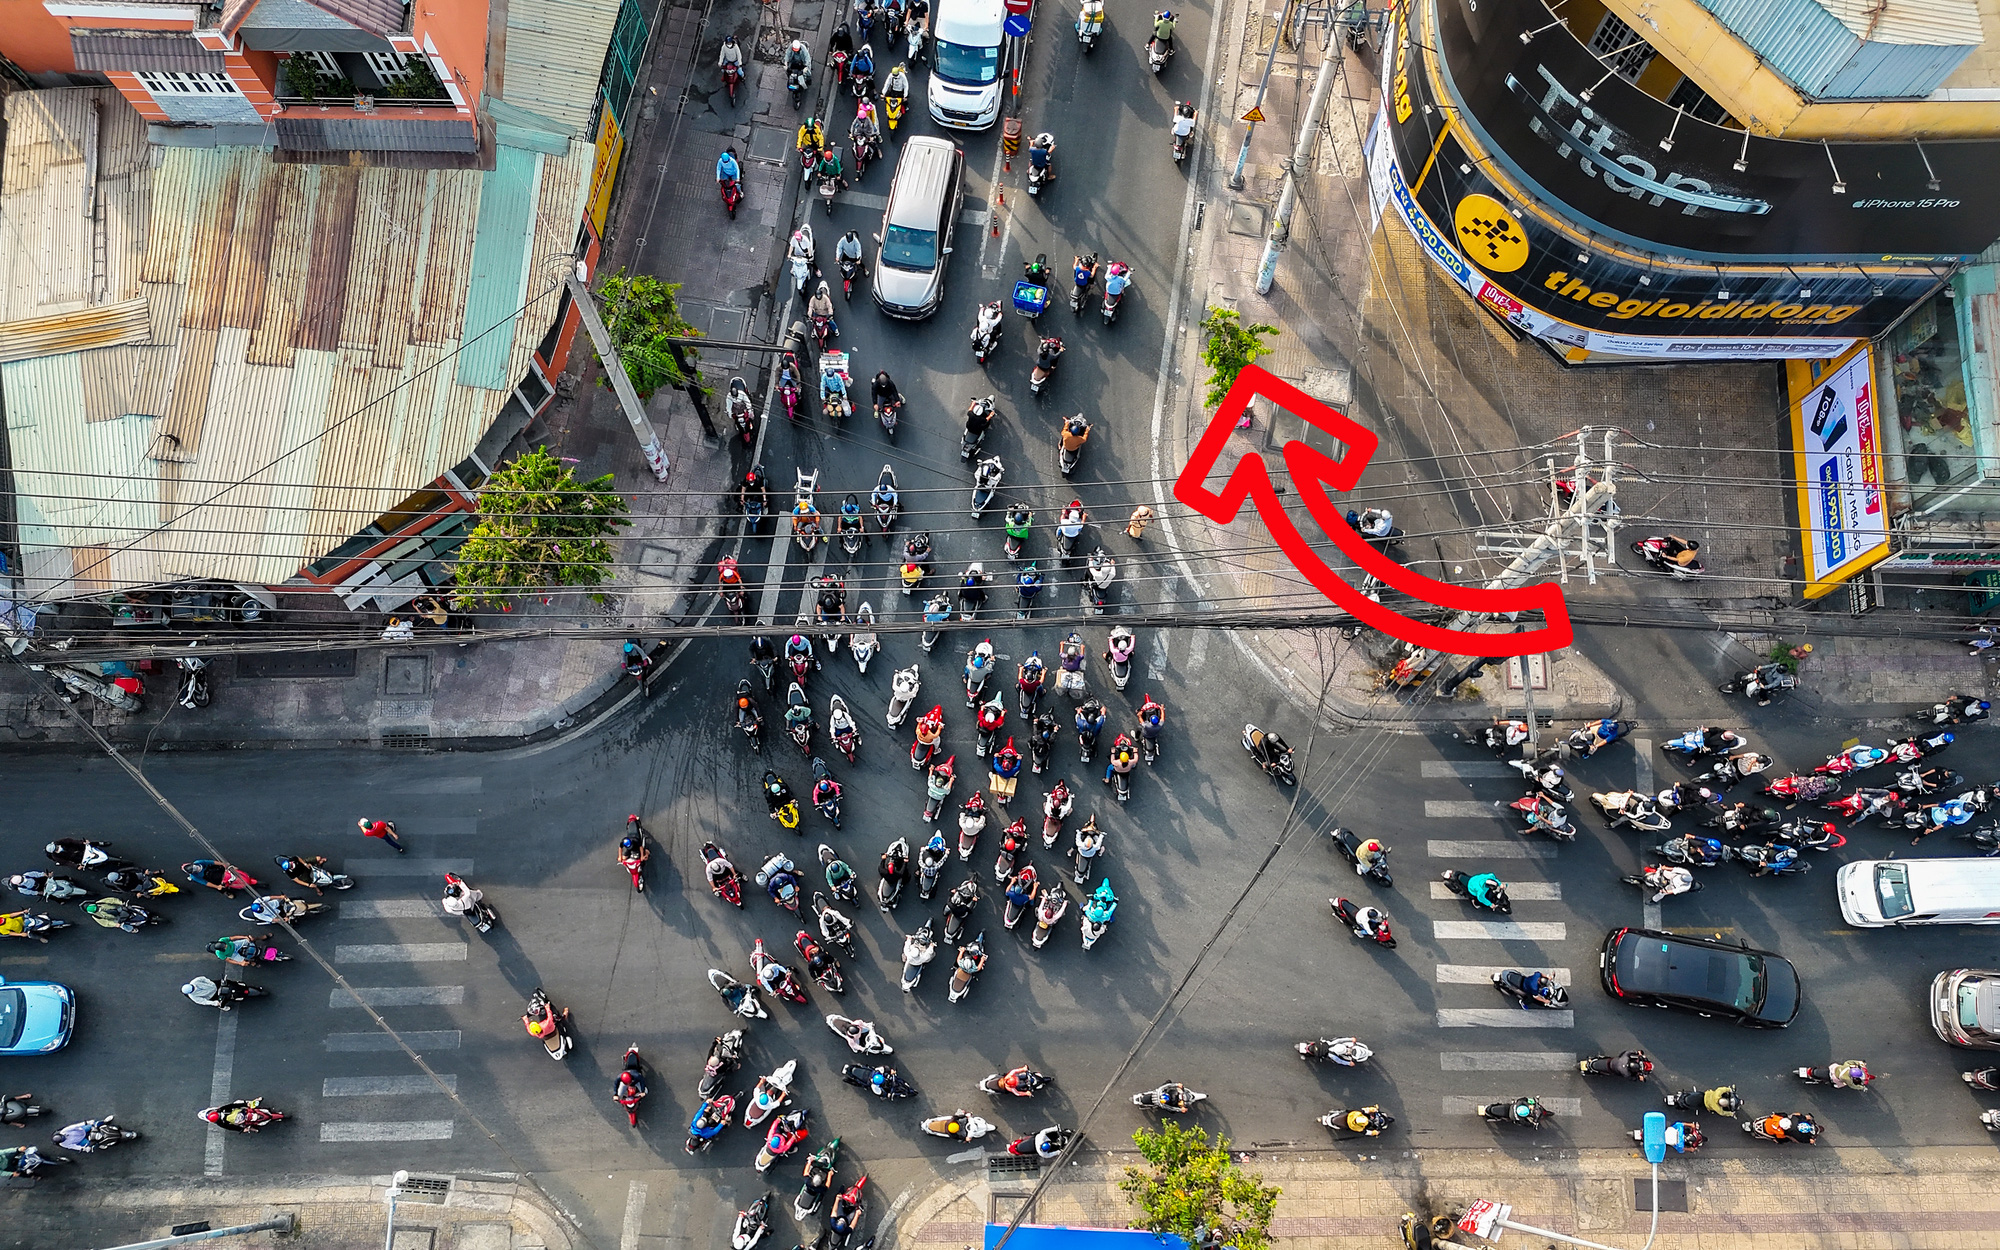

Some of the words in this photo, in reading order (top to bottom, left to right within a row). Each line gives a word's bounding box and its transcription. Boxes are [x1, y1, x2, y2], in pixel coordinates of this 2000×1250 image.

[1528, 63, 1712, 215] Titan
[1863, 199, 1916, 208] iPhone
[1916, 199, 1936, 208] 15
[1933, 199, 1960, 208] Pro
[1543, 270, 1863, 325] thegioididong
[1845, 445, 1855, 497] Galaxy
[1850, 499, 1859, 529] M54
